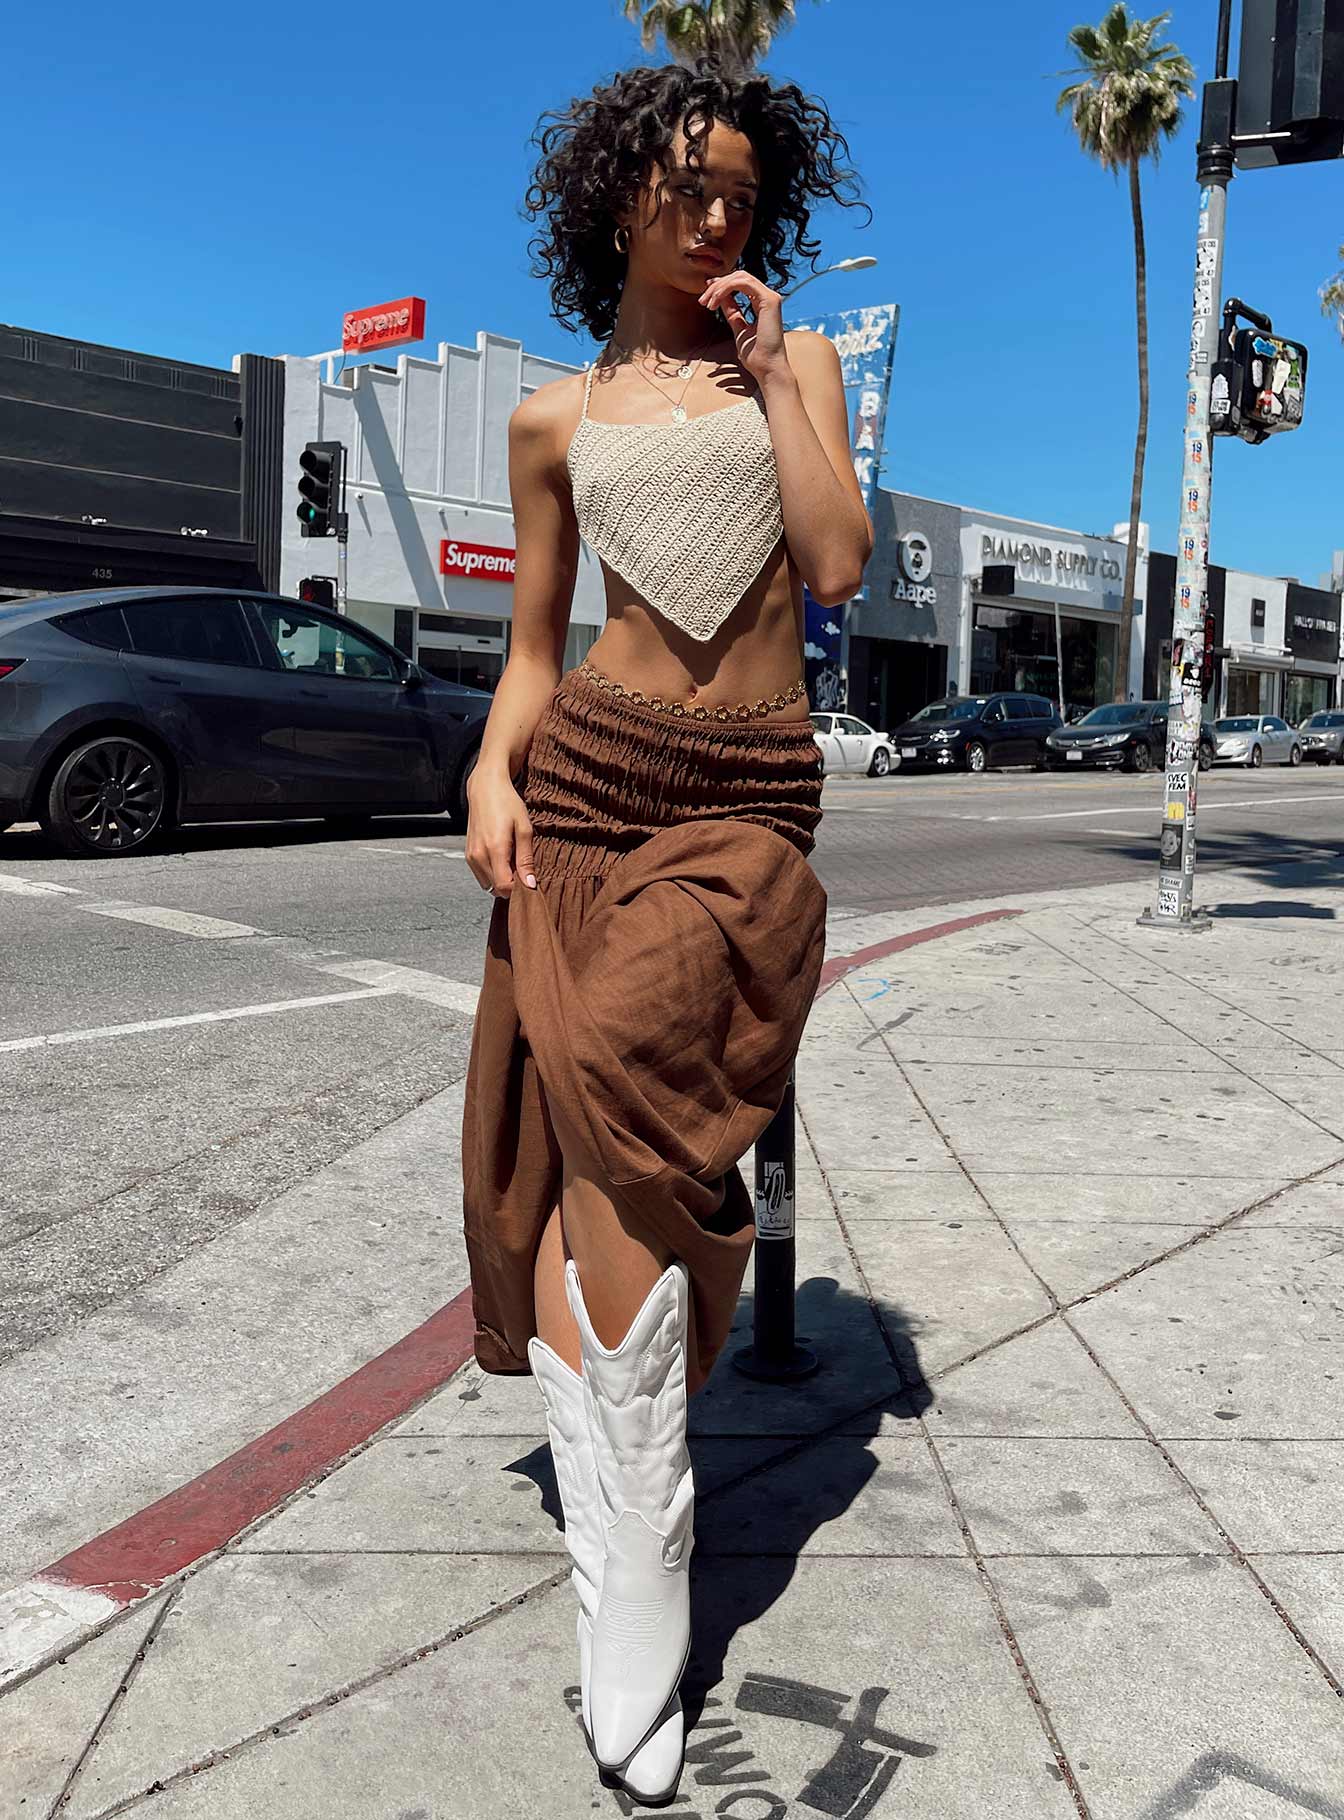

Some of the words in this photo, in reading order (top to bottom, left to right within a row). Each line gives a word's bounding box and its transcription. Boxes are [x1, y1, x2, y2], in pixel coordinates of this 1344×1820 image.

[342, 307, 410, 344] Supreme
[1192, 442, 1202, 453] 19
[1191, 453, 1202, 464] 15
[1188, 490, 1199, 501] 19
[1188, 501, 1198, 512] 15
[1184, 539, 1194, 550] 19
[982, 535, 1052, 568] DIAMOND
[1057, 550, 1098, 577] SUPPLY
[1100, 559, 1122, 582] CO.
[1183, 550, 1194, 560] 15
[91, 567, 113, 579] 435
[894, 578, 937, 609] Aape
[1180, 587, 1191, 598] 19
[1180, 598, 1190, 609] 15
